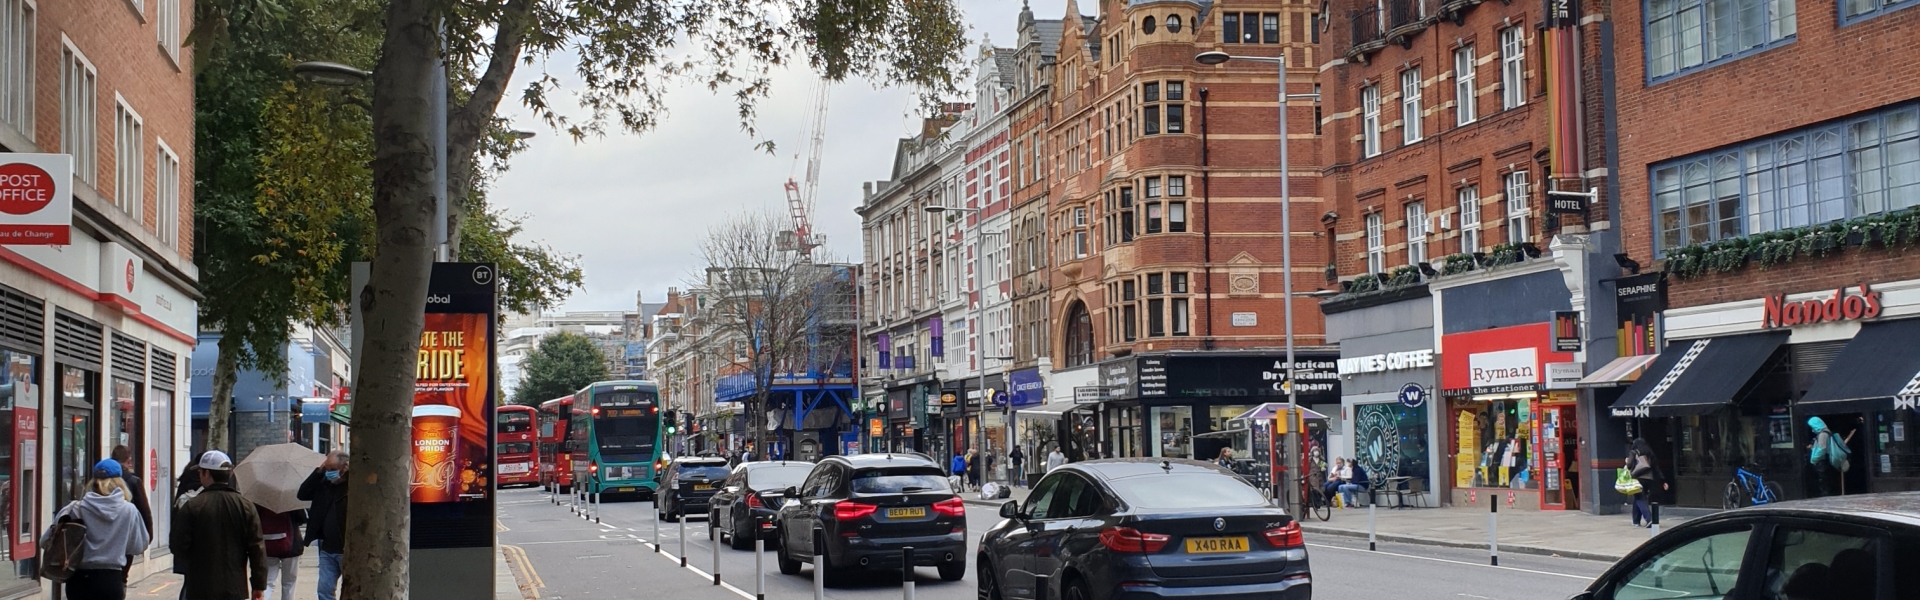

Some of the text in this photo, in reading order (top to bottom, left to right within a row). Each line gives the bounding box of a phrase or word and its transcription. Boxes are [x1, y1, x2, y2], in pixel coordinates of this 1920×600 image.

[0, 174, 41, 187] POST
[1554, 199, 1581, 210] HOTEL
[12, 230, 22, 238] de
[24, 229, 54, 239] Change
[476, 271, 489, 279] BT
[1617, 283, 1657, 297] SERAPHINE
[427, 294, 451, 304] obal
[1761, 283, 1882, 329] Nando's
[441, 331, 465, 348] THE
[416, 349, 465, 380] RIDE
[1386, 349, 1434, 371] COFFEE
[1262, 371, 1286, 381] Dry
[1472, 366, 1534, 383] Ryman
[1491, 384, 1535, 393] stationer
[1405, 391, 1420, 401] W
[1368, 434, 1383, 463] W
[1194, 537, 1242, 551] X40 RAA
